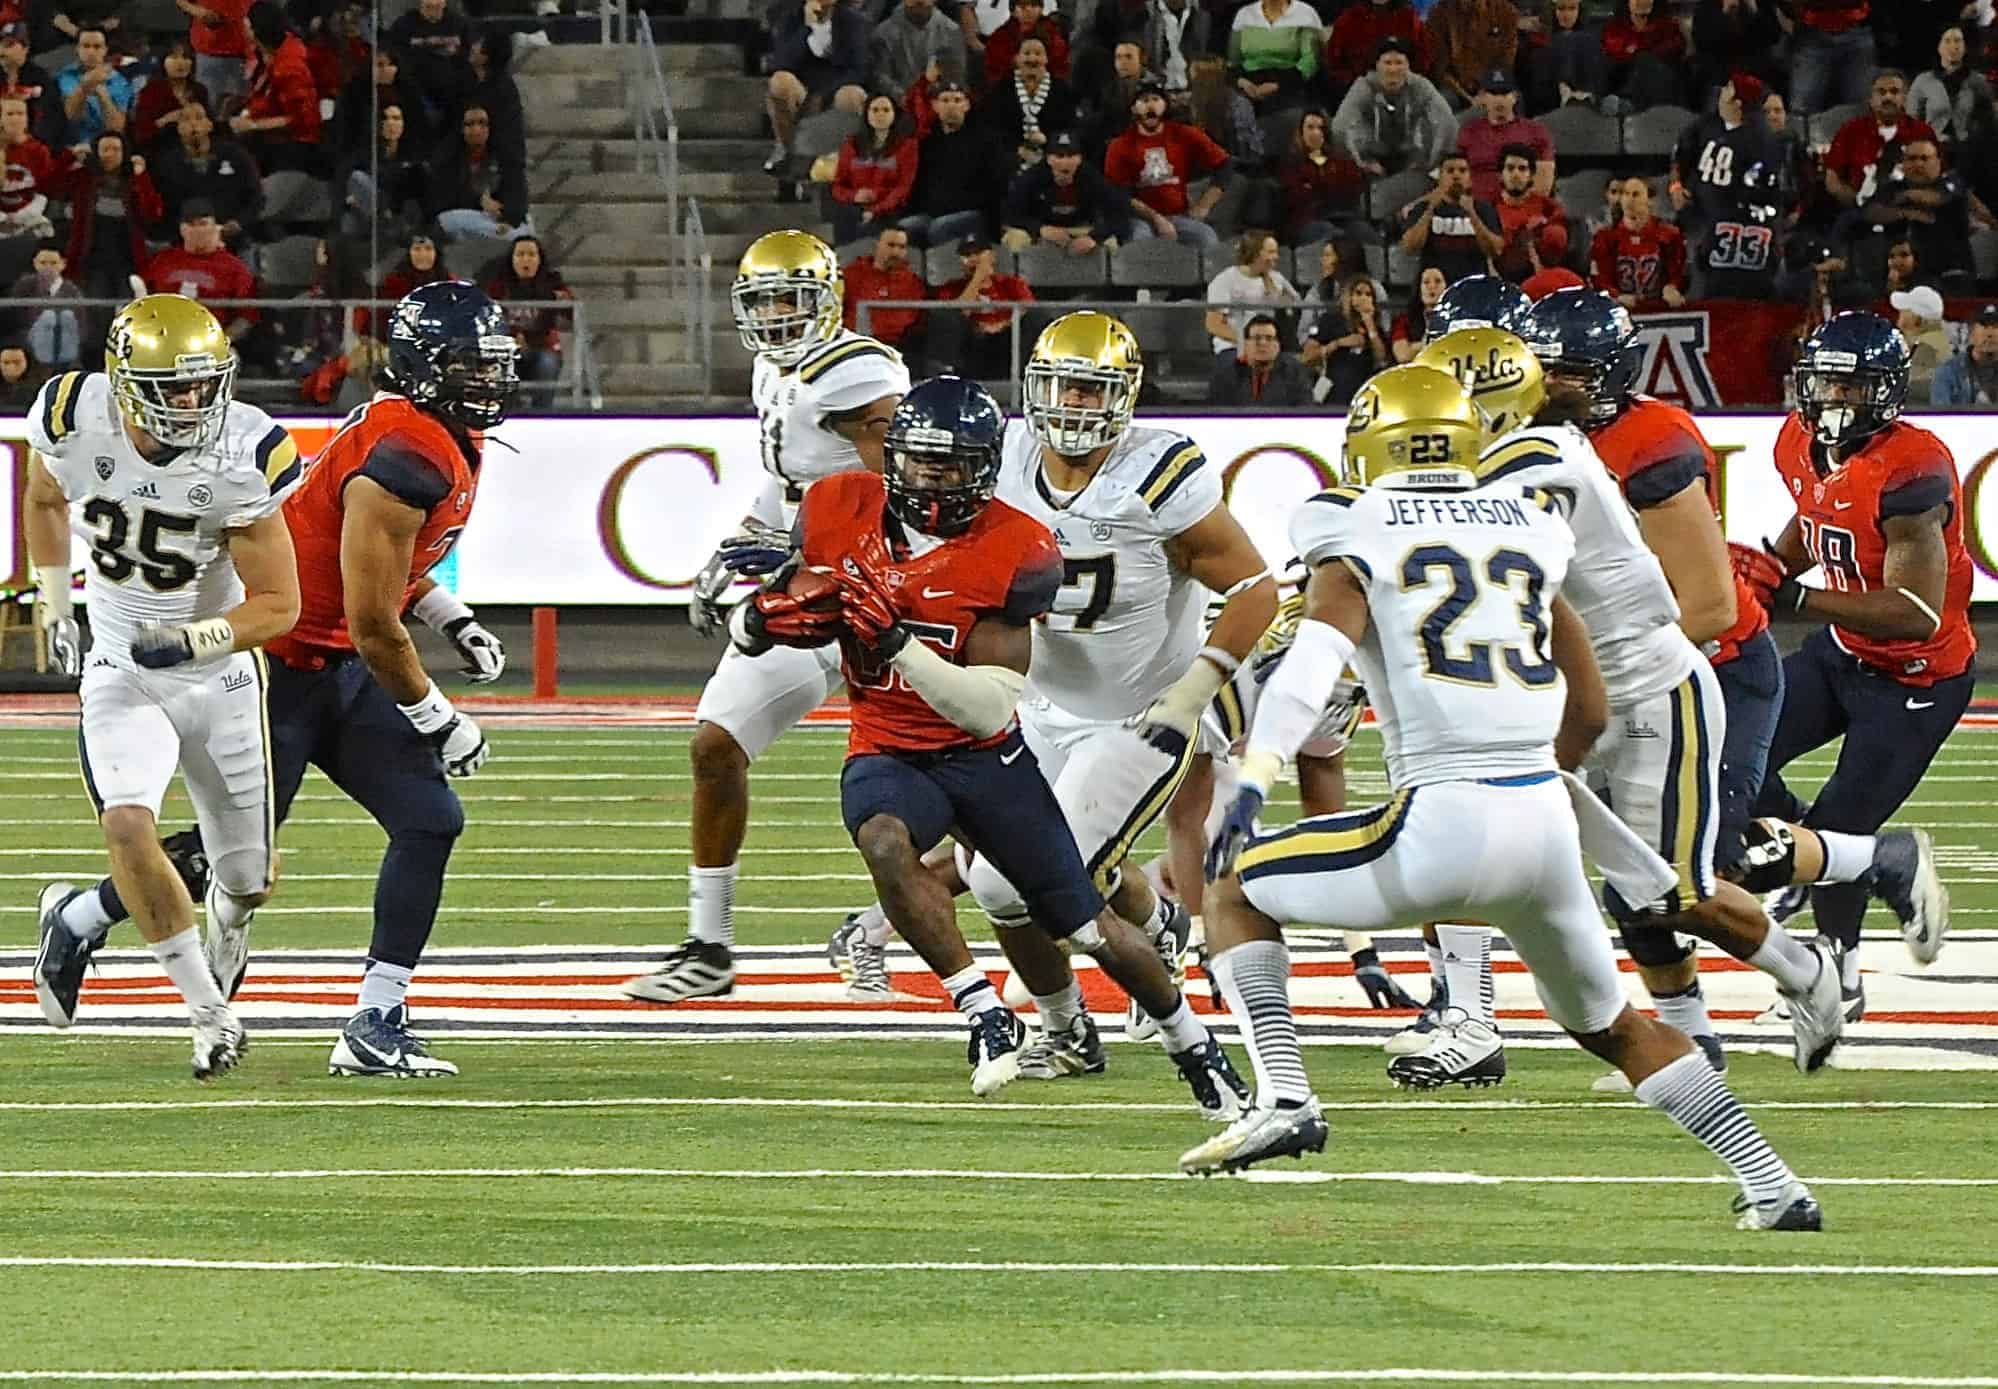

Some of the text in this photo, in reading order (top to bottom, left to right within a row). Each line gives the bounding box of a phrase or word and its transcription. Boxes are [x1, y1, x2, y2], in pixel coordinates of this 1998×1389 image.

[1698, 140, 1734, 187] 48
[1708, 221, 1773, 271] 33
[1410, 434, 1450, 464] 23
[1407, 473, 1460, 485] BRUINS
[1385, 498, 1530, 527] JEFFERSON
[83, 494, 199, 592] 35
[1397, 540, 1560, 690] 23
